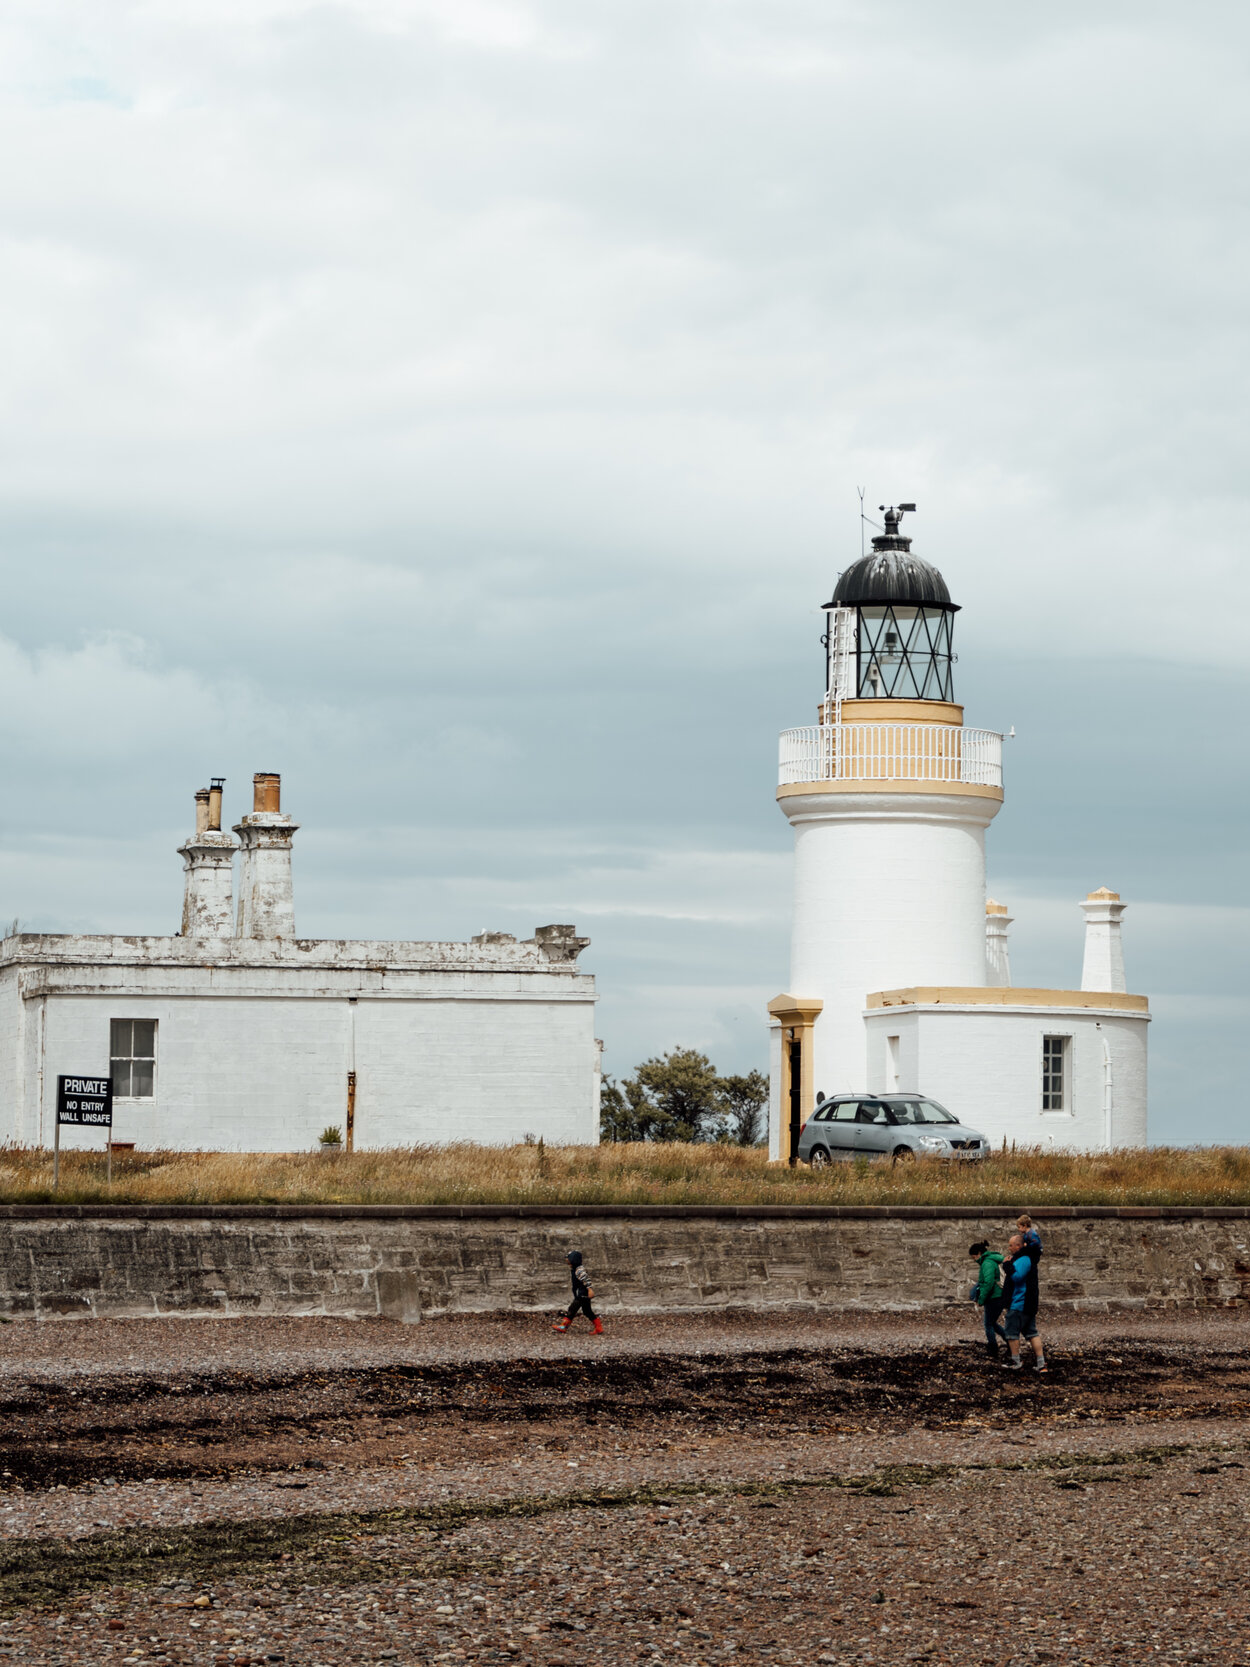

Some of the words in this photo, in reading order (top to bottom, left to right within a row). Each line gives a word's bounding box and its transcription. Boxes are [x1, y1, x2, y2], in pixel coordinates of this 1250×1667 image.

[64, 1079, 107, 1094] PRIVATE
[66, 1100, 78, 1110] NO
[81, 1101, 104, 1111] ENTRY
[59, 1111, 79, 1121] WALL
[82, 1113, 111, 1123] UNSAFE
